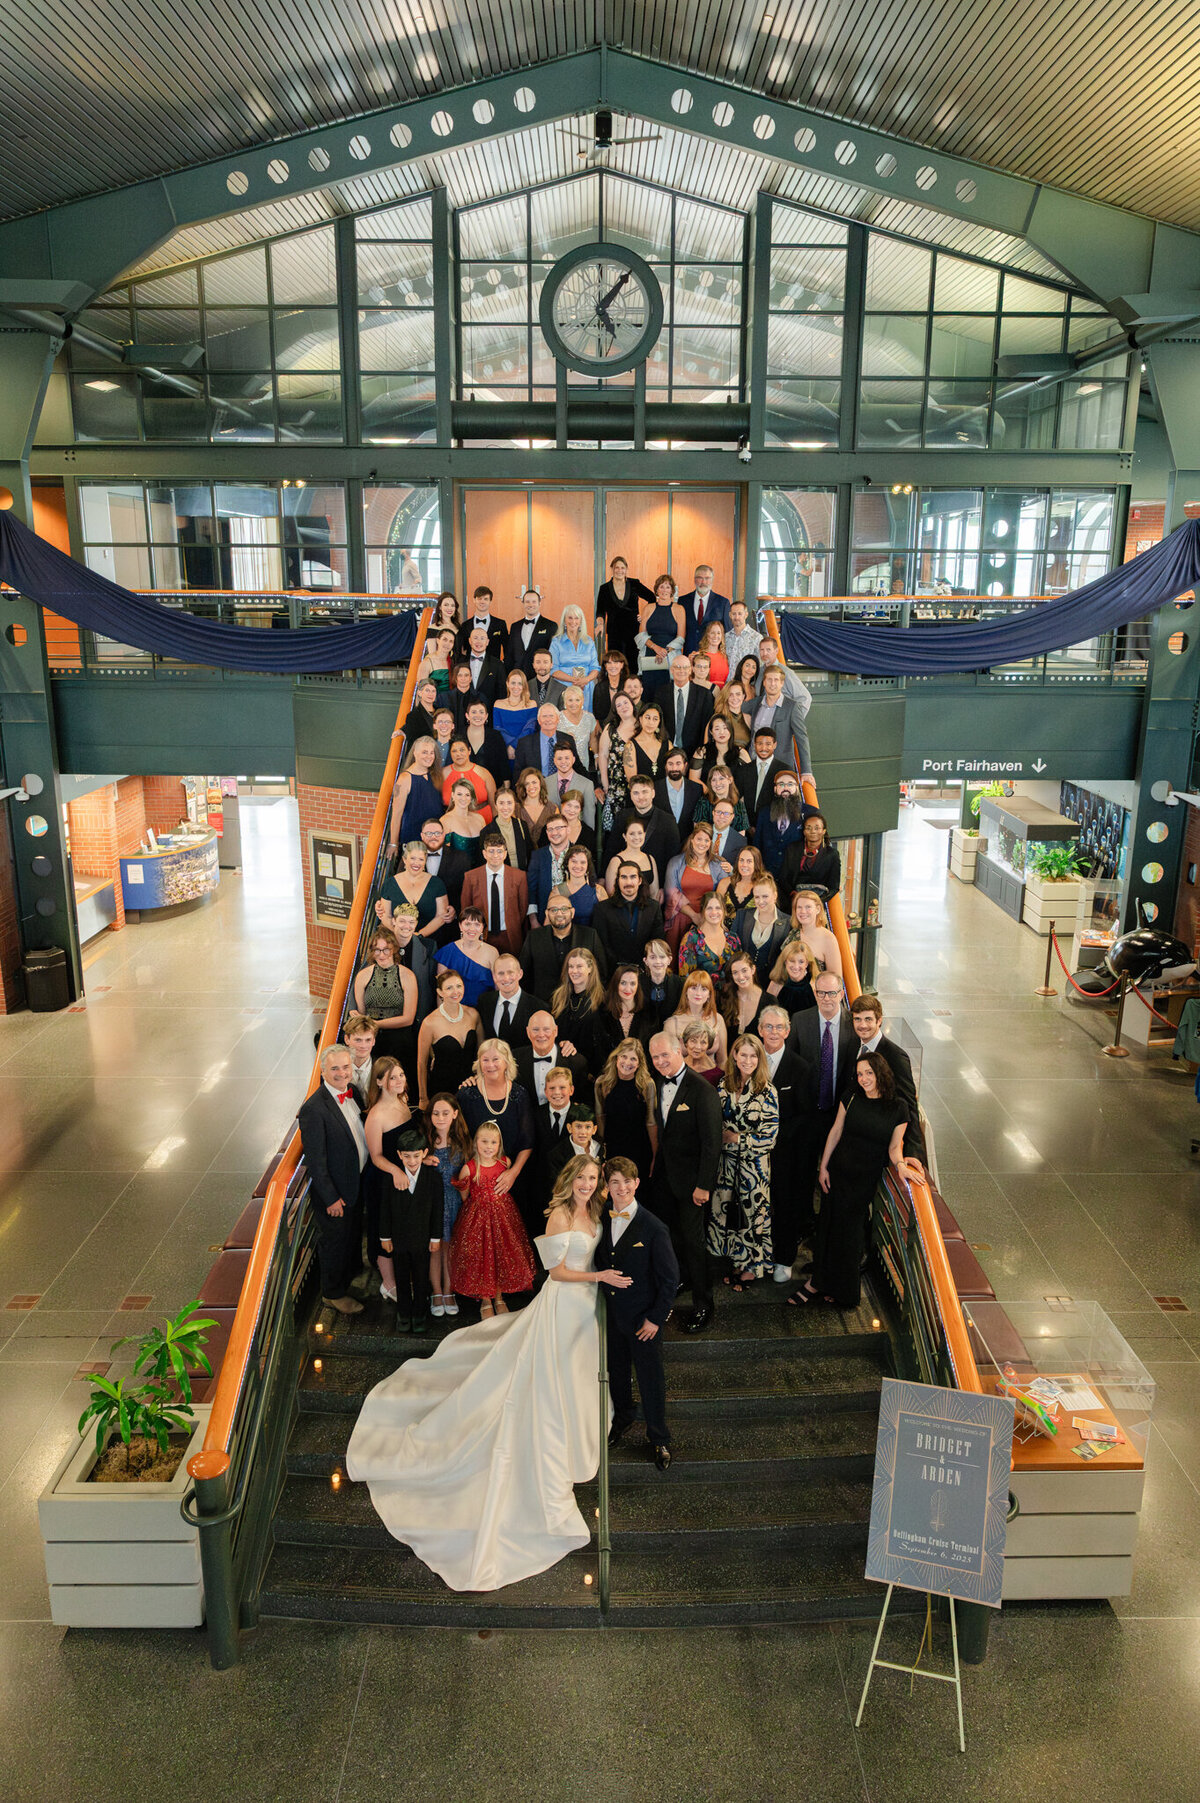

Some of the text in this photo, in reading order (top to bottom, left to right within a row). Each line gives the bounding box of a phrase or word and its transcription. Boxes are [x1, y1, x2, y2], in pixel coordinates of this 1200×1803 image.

[923, 759, 1023, 772] Port Fairhaven
[916, 1432, 972, 1457] BRIDGET
[939, 1455, 945, 1464] &
[921, 1464, 962, 1487] ARDEN
[893, 1528, 979, 1555] Bellingham Cruise Terminal
